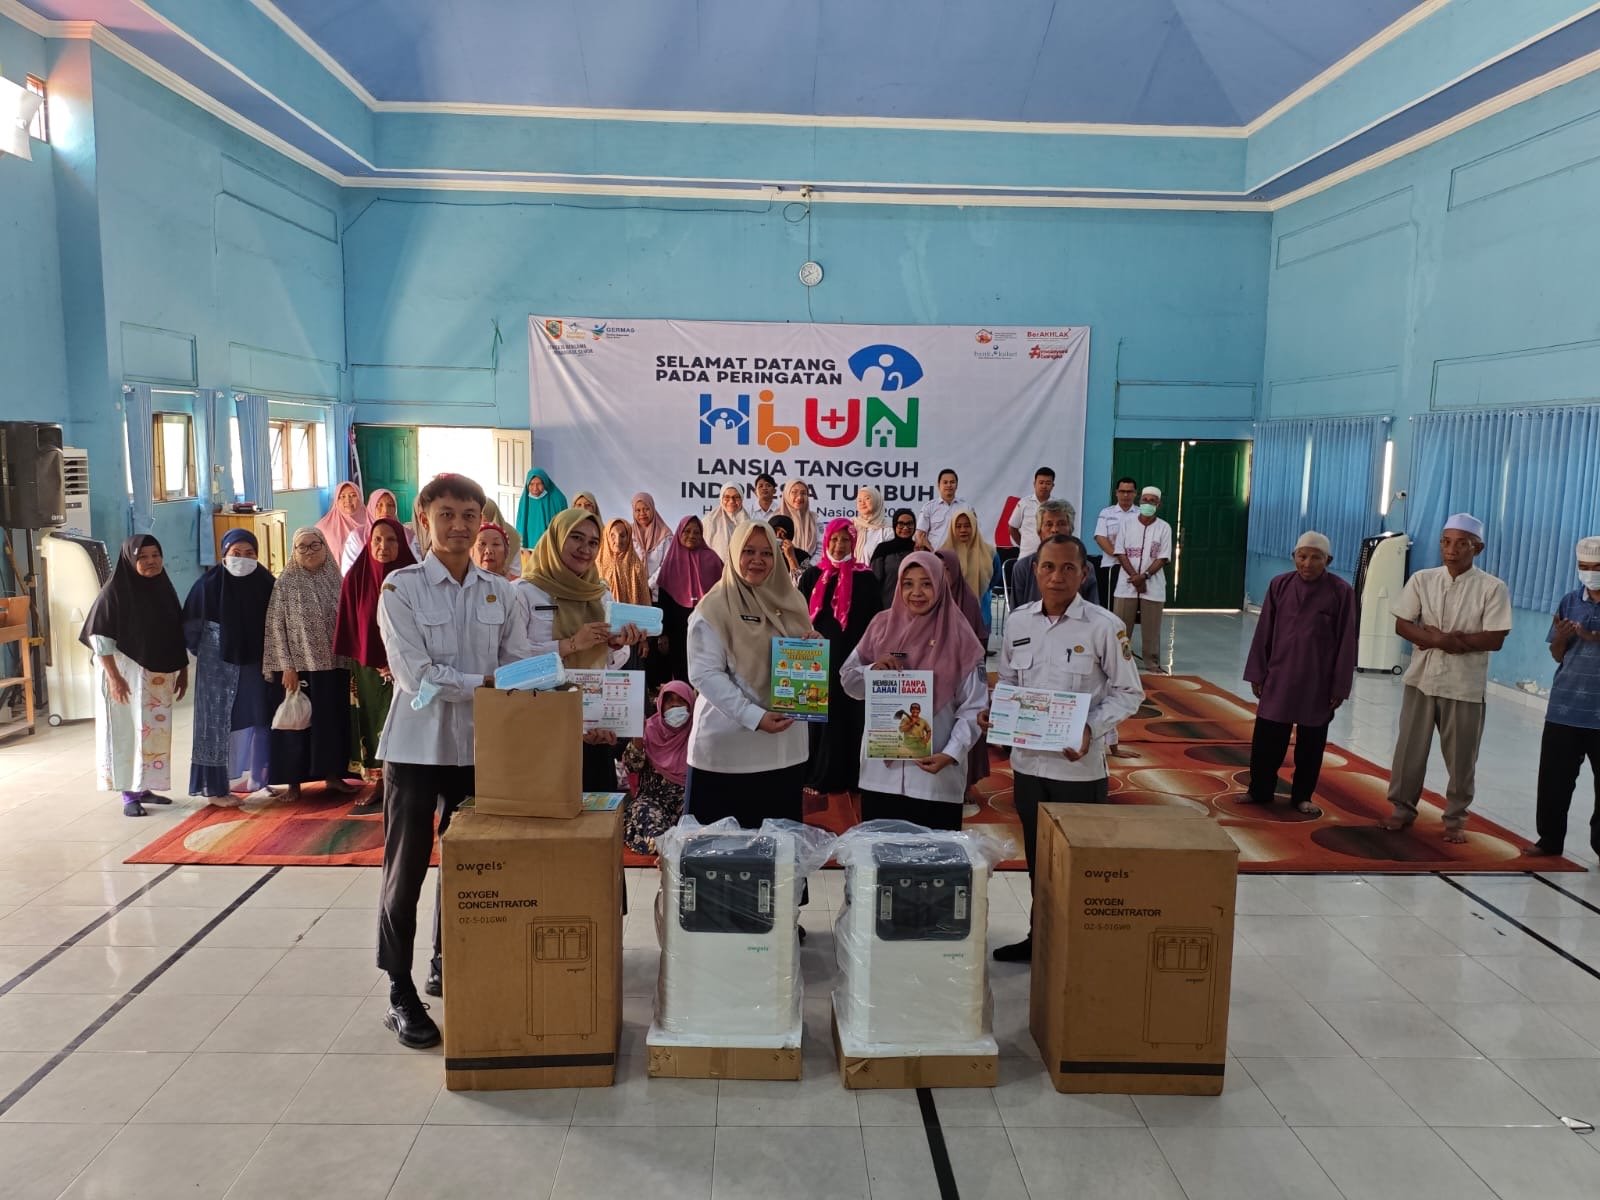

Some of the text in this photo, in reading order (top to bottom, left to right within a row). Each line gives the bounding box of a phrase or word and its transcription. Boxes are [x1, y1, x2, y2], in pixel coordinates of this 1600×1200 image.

[1027, 330, 1069, 338] BerAKHLAK
[655, 355, 836, 371] SELAMAT DATANG
[655, 369, 842, 385] PADA PERINGATAN
[697, 458, 919, 478] LANSIA TANGGUH
[826, 484, 935, 502] TUBUH
[456, 861, 503, 875] owgels
[1084, 869, 1129, 883] owgels
[457, 890, 499, 900] OXYGEN
[1084, 897, 1124, 906] OXYGEN
[458, 899, 538, 910] CONCENTRATOR
[1084, 908, 1162, 917] CONCENTRATOR
